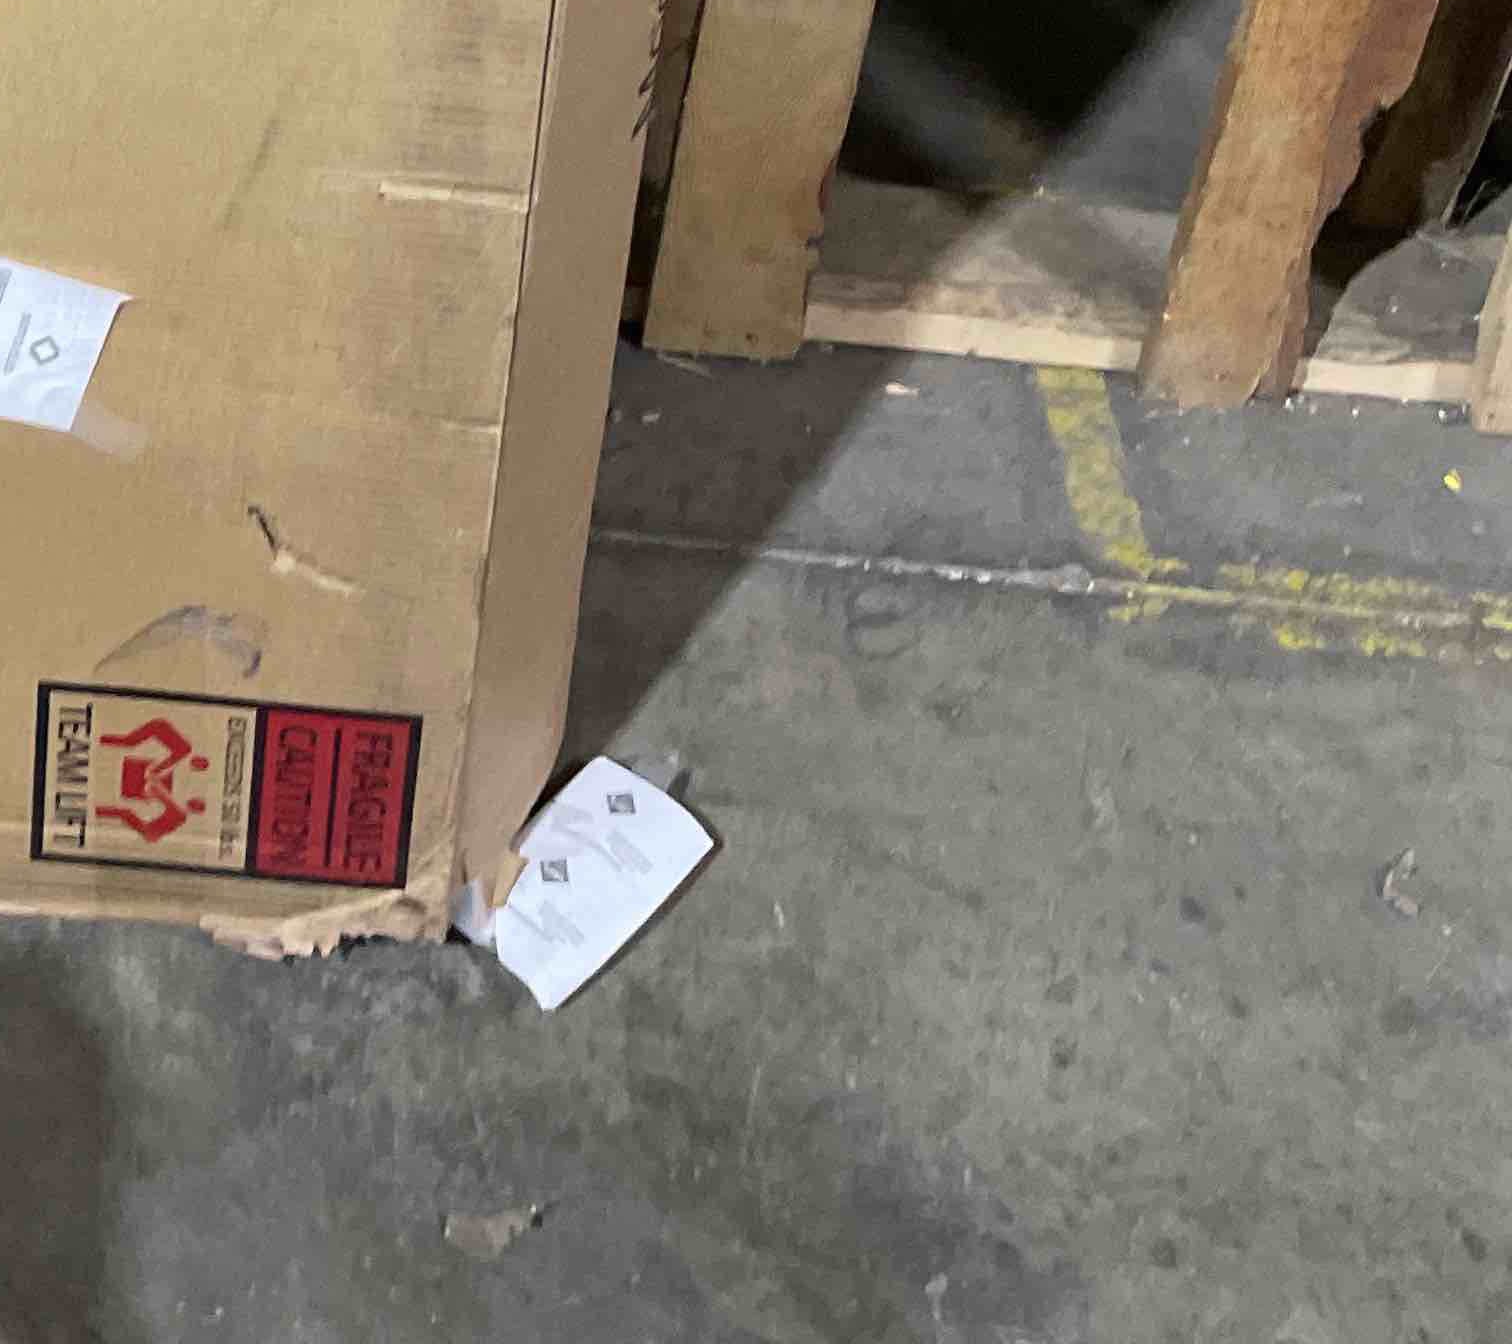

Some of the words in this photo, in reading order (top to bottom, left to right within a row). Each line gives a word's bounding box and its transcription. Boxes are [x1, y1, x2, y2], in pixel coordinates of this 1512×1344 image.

[54, 702, 95, 784] TEAM
[269, 723, 318, 867] CAUTION
[52, 791, 88, 850] LIFT
[343, 731, 393, 872] FRAGILE
